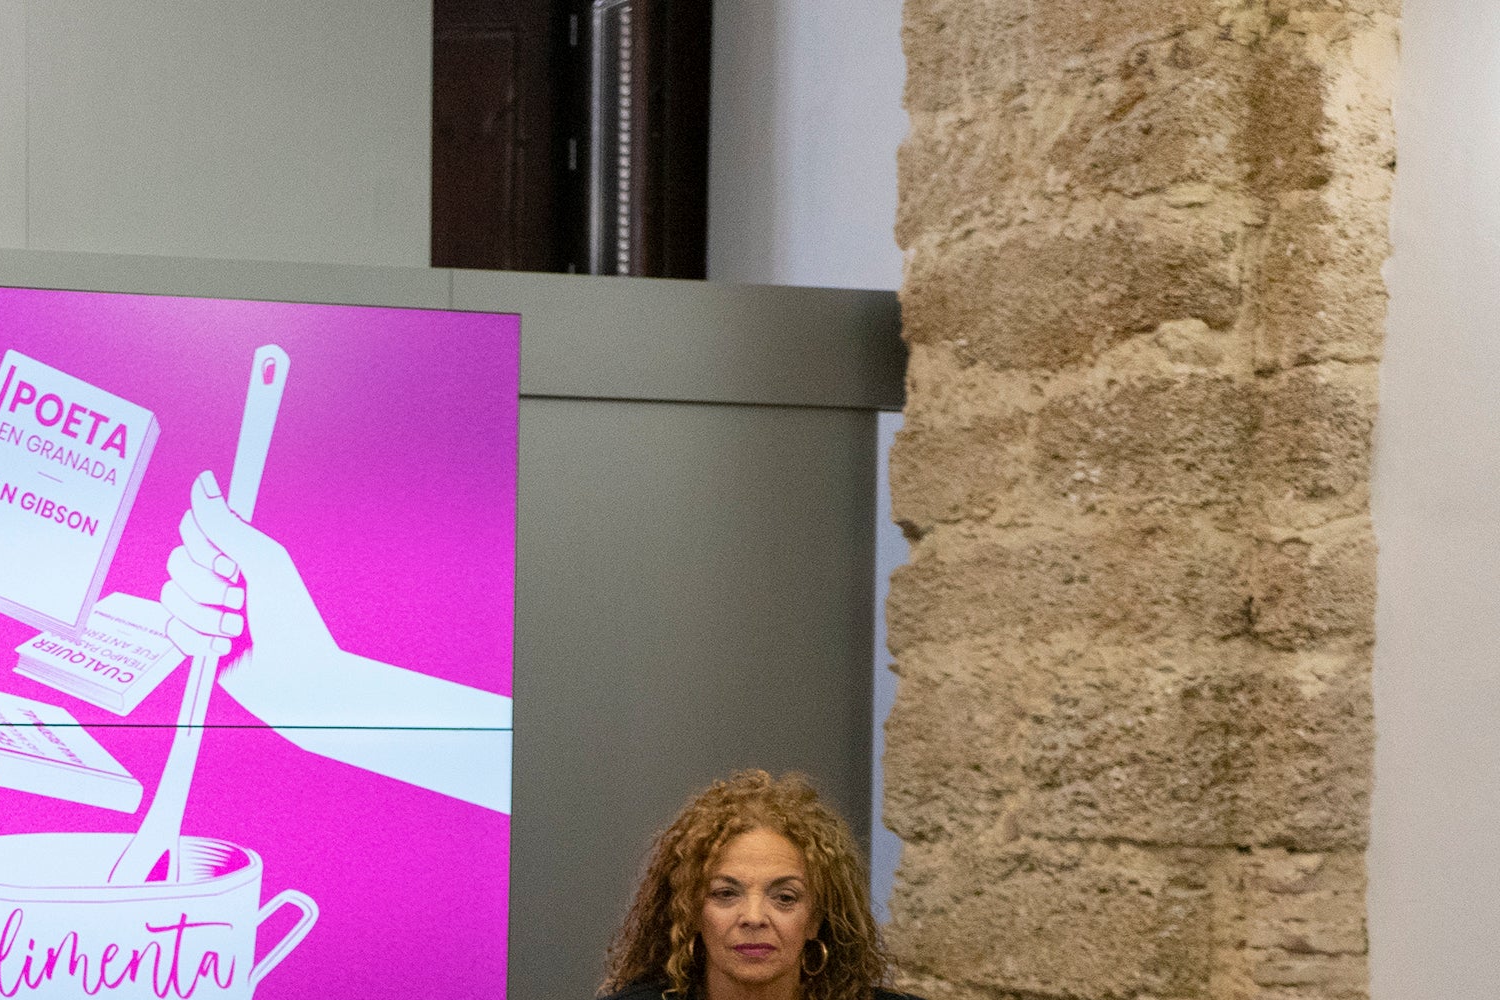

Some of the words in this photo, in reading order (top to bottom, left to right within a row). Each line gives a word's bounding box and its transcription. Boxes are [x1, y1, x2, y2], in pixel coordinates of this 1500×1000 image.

[8, 380, 127, 459] POETA
[26, 435, 117, 486] GRANADA
[20, 492, 99, 537] GIBSON
[32, 638, 135, 684] CUALQUIER
